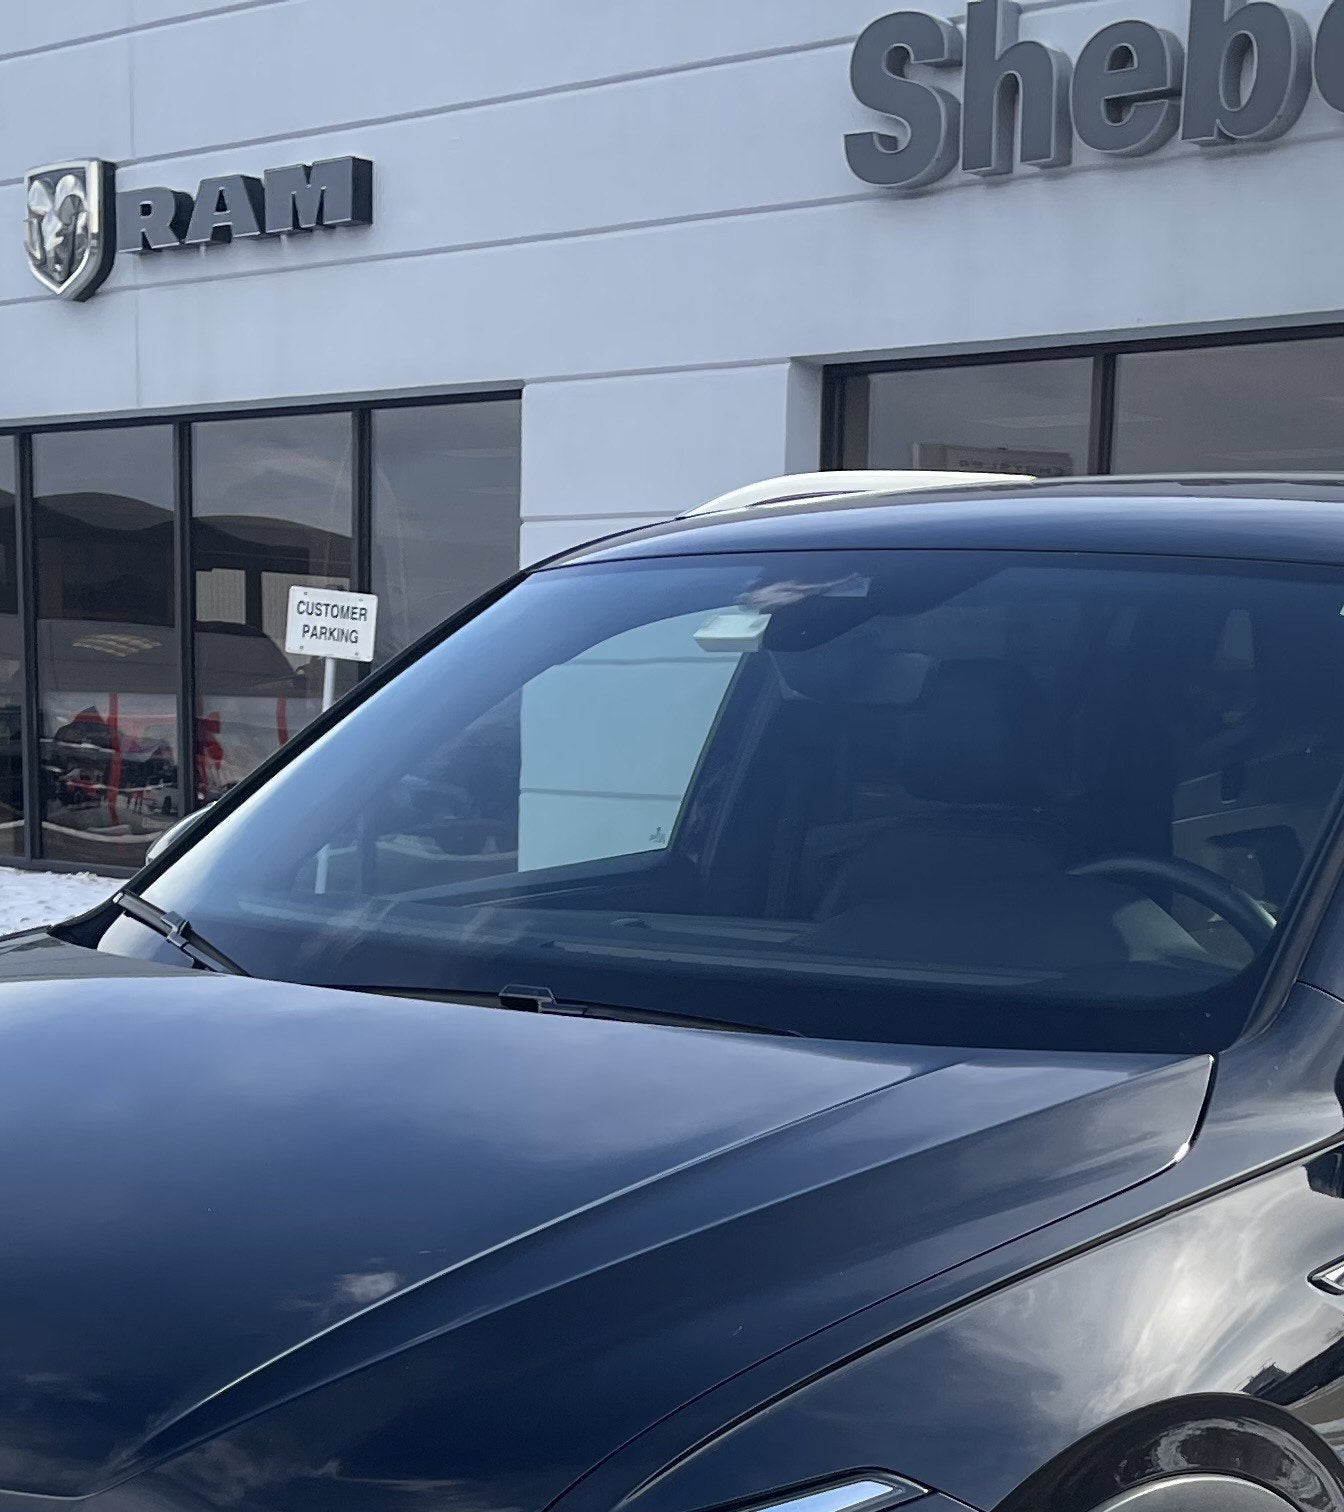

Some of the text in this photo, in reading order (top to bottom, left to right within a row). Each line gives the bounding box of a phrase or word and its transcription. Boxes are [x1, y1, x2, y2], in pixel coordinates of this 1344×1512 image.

[116, 155, 373, 253] RAM
[296, 600, 368, 621] CUSTOMER
[301, 624, 359, 643] PARKING
